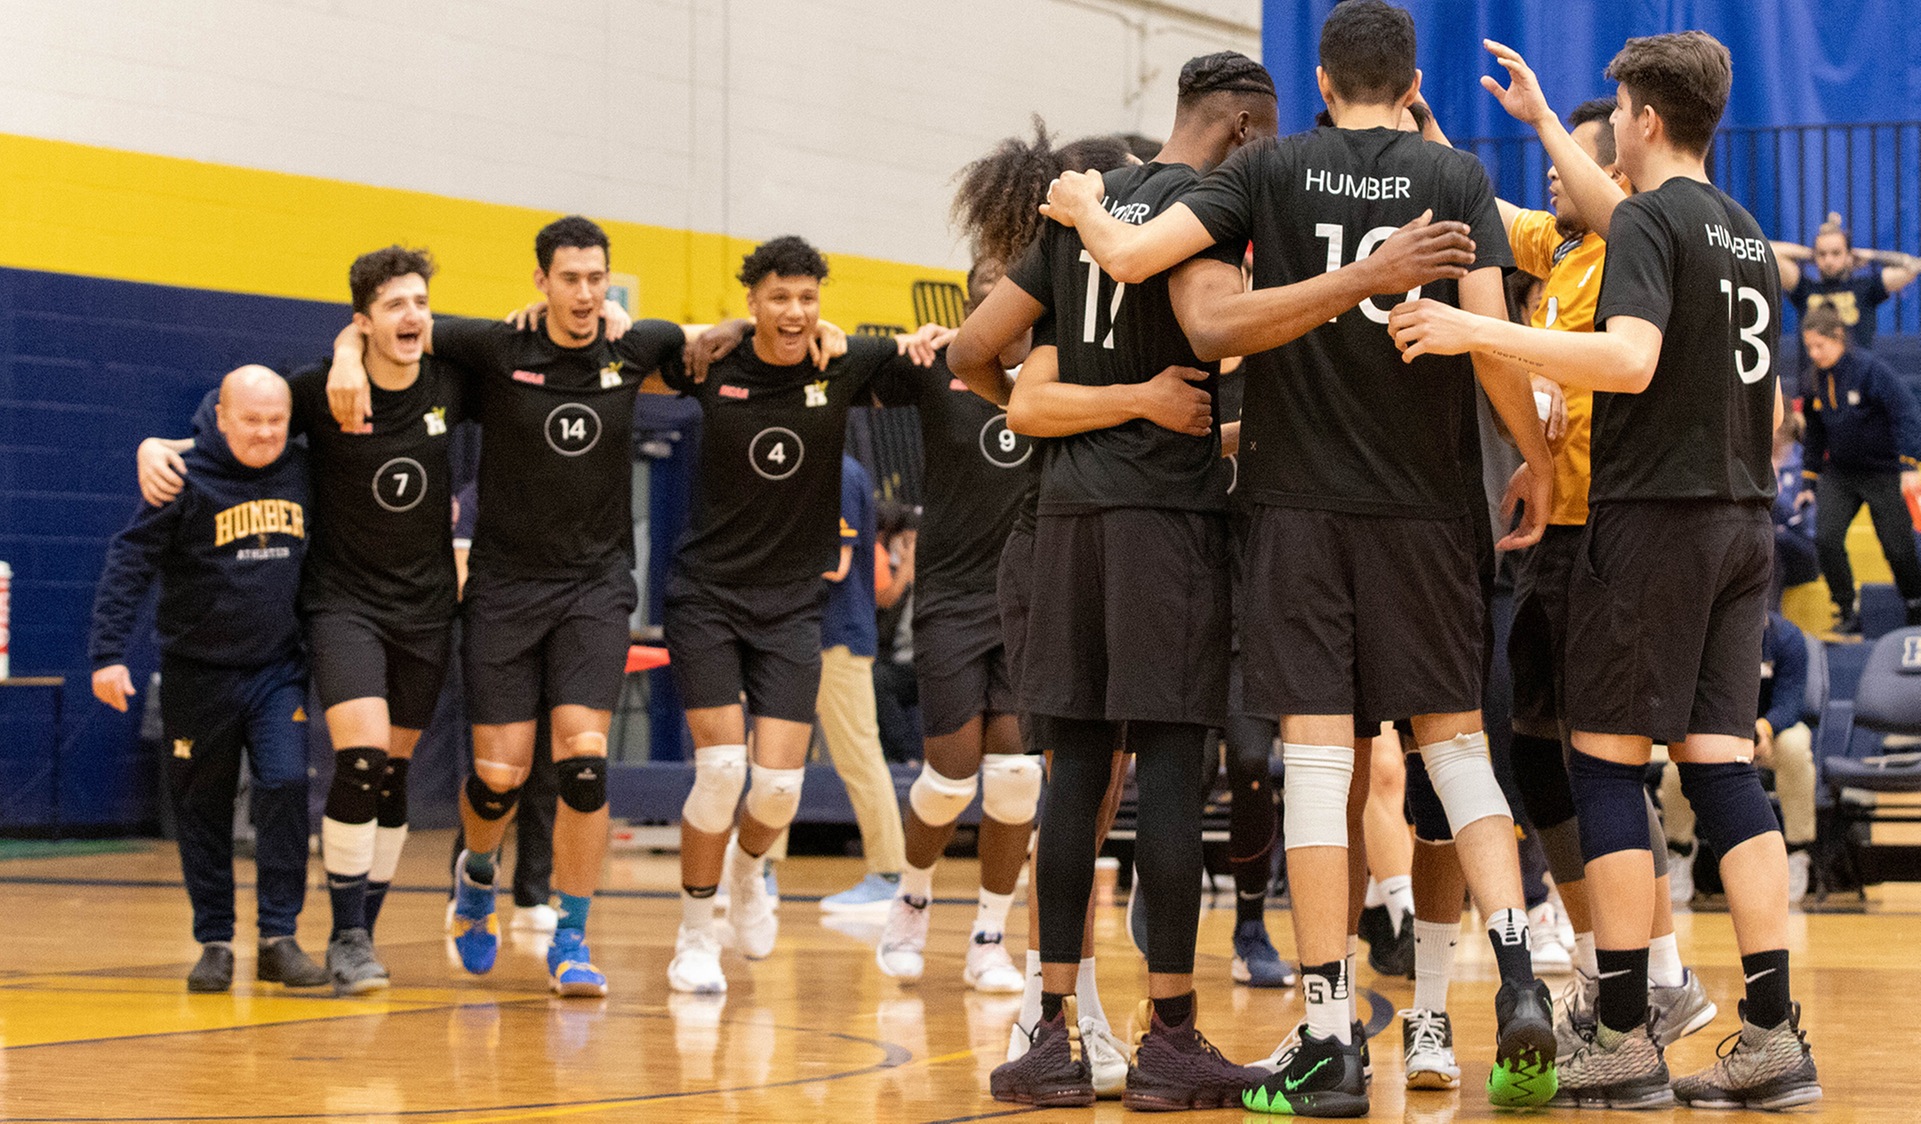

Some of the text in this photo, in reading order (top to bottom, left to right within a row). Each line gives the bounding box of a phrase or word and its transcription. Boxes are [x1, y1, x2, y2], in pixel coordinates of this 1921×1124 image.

[1305, 168, 1411, 200] HUMBER
[1720, 278, 1770, 384] 13
[559, 417, 587, 441] 14
[998, 429, 1016, 453] 9
[767, 441, 787, 465] 4
[392, 472, 409, 497] 7
[214, 498, 305, 548] HUMBER
